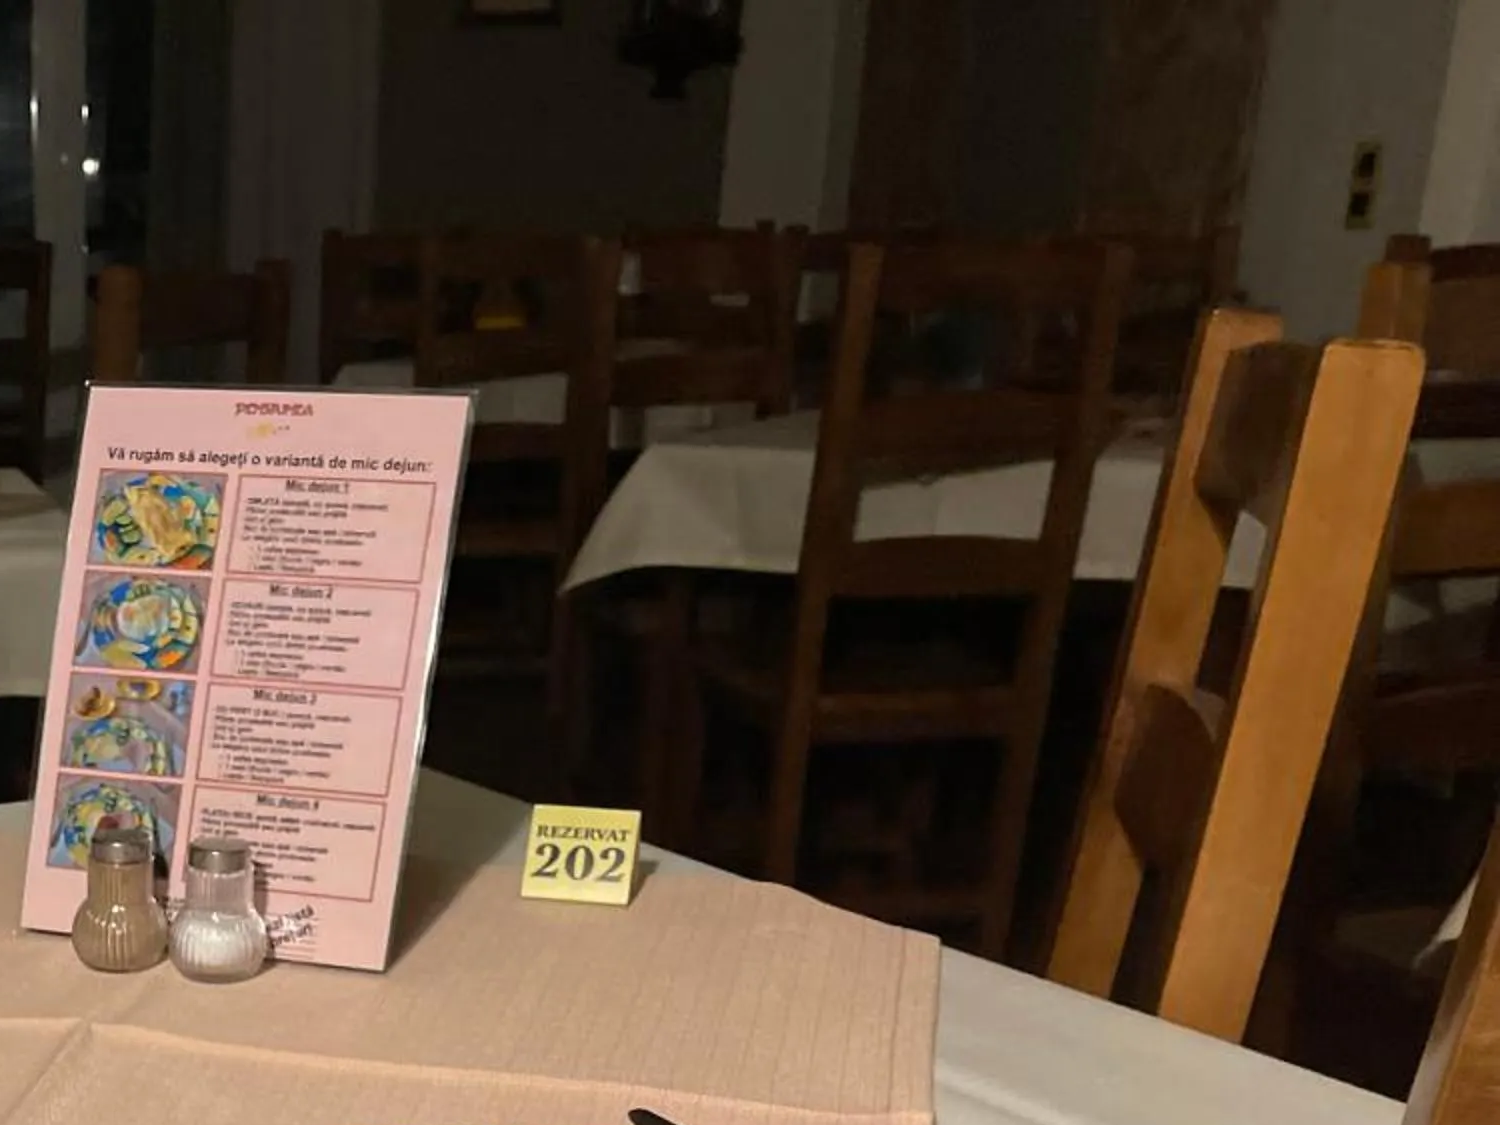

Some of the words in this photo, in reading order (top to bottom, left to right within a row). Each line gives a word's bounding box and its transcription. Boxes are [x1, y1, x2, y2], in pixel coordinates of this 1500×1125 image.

[107, 447, 125, 460] Vă
[130, 450, 174, 465] rugăm
[178, 450, 195, 463] să
[251, 455, 261, 466] o
[265, 454, 324, 468] variantă
[328, 456, 346, 469] de
[351, 457, 379, 471] mic
[383, 458, 432, 475] dejun:
[536, 825, 630, 842] REZERVAT
[530, 843, 626, 882] 202
